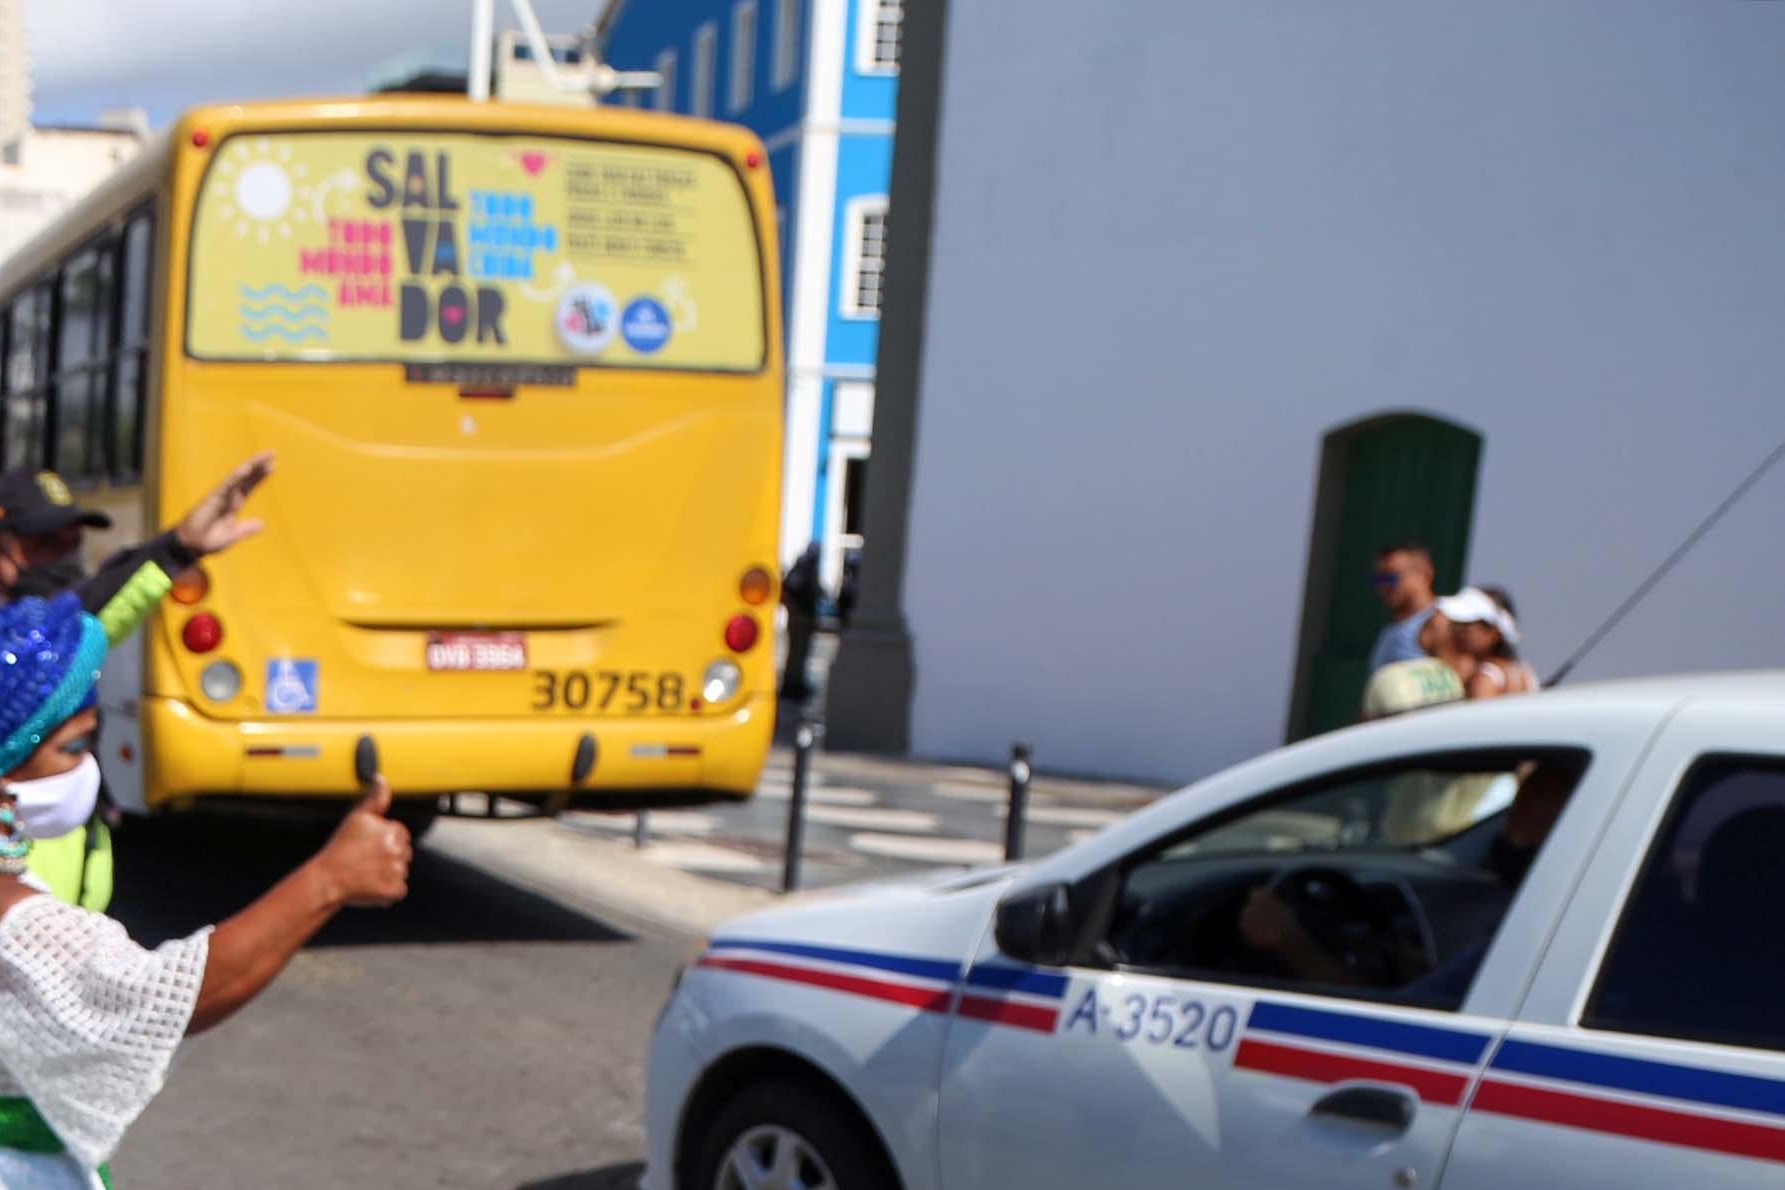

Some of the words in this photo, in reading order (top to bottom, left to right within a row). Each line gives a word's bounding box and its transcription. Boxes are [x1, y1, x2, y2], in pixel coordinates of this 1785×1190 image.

[366, 150, 459, 210] SAL
[402, 218, 460, 276] VA
[399, 285, 506, 344] DOR
[532, 669, 684, 712] 30758
